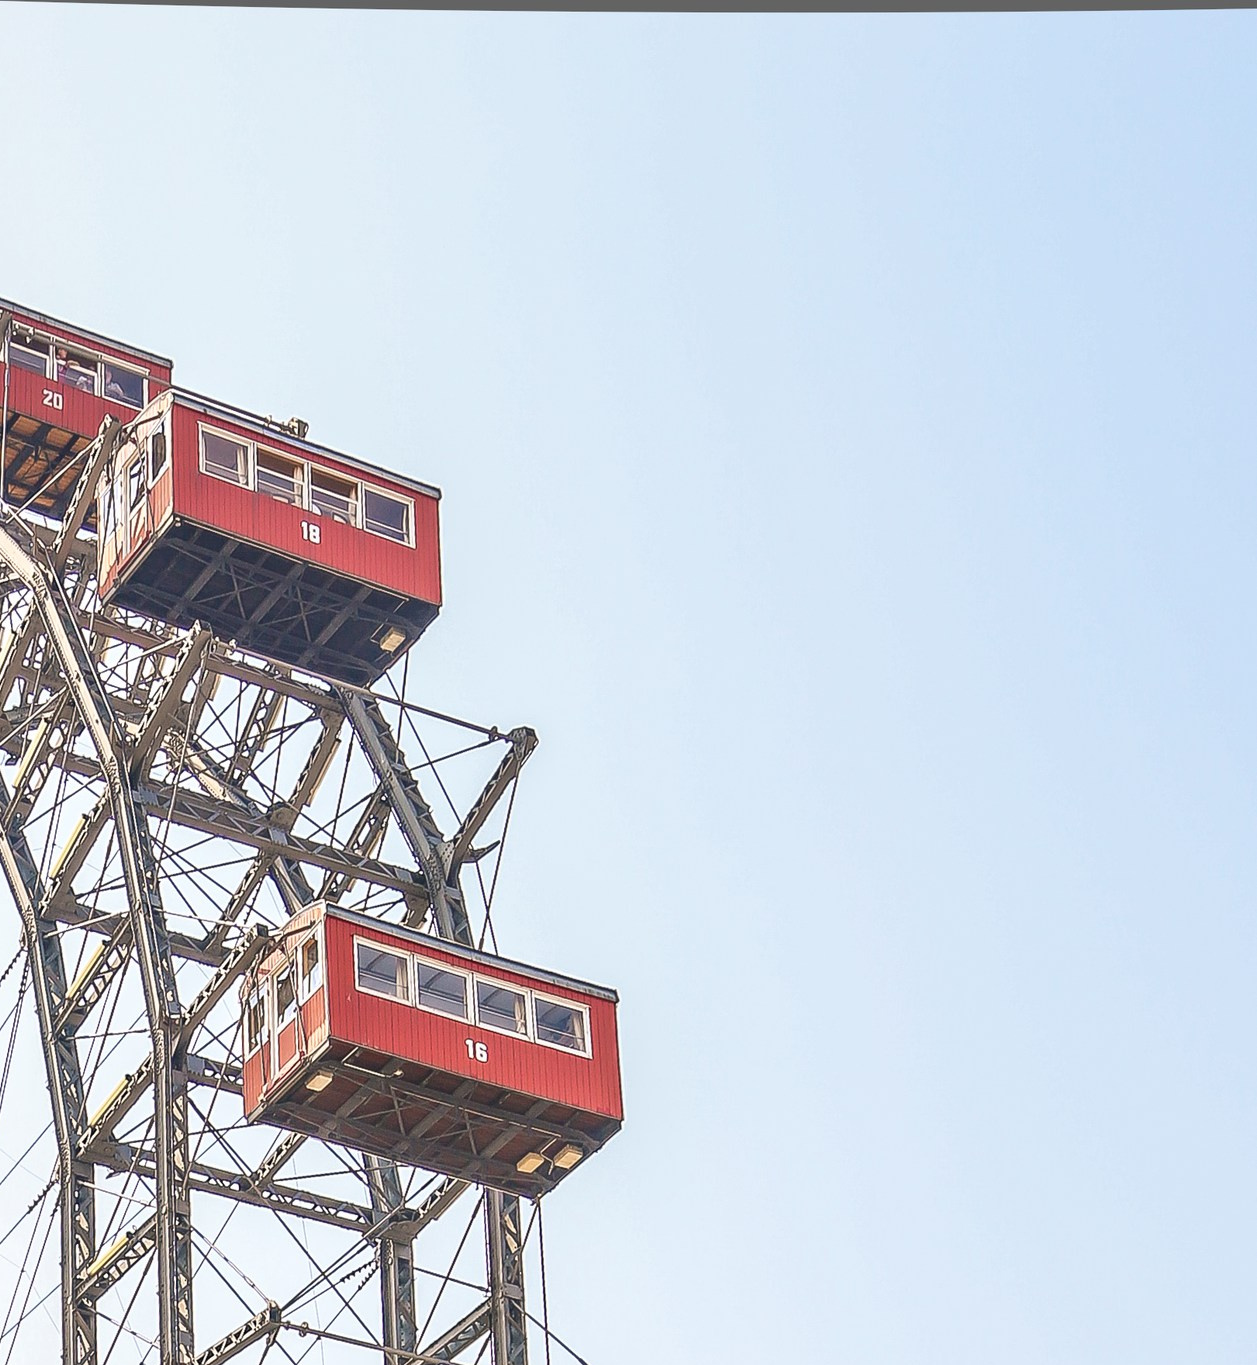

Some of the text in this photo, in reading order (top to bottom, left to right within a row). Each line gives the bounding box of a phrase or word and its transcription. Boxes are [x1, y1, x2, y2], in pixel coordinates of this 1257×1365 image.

[43, 388, 63, 411] 20
[301, 520, 321, 545] 18
[465, 1038, 488, 1063] 16
